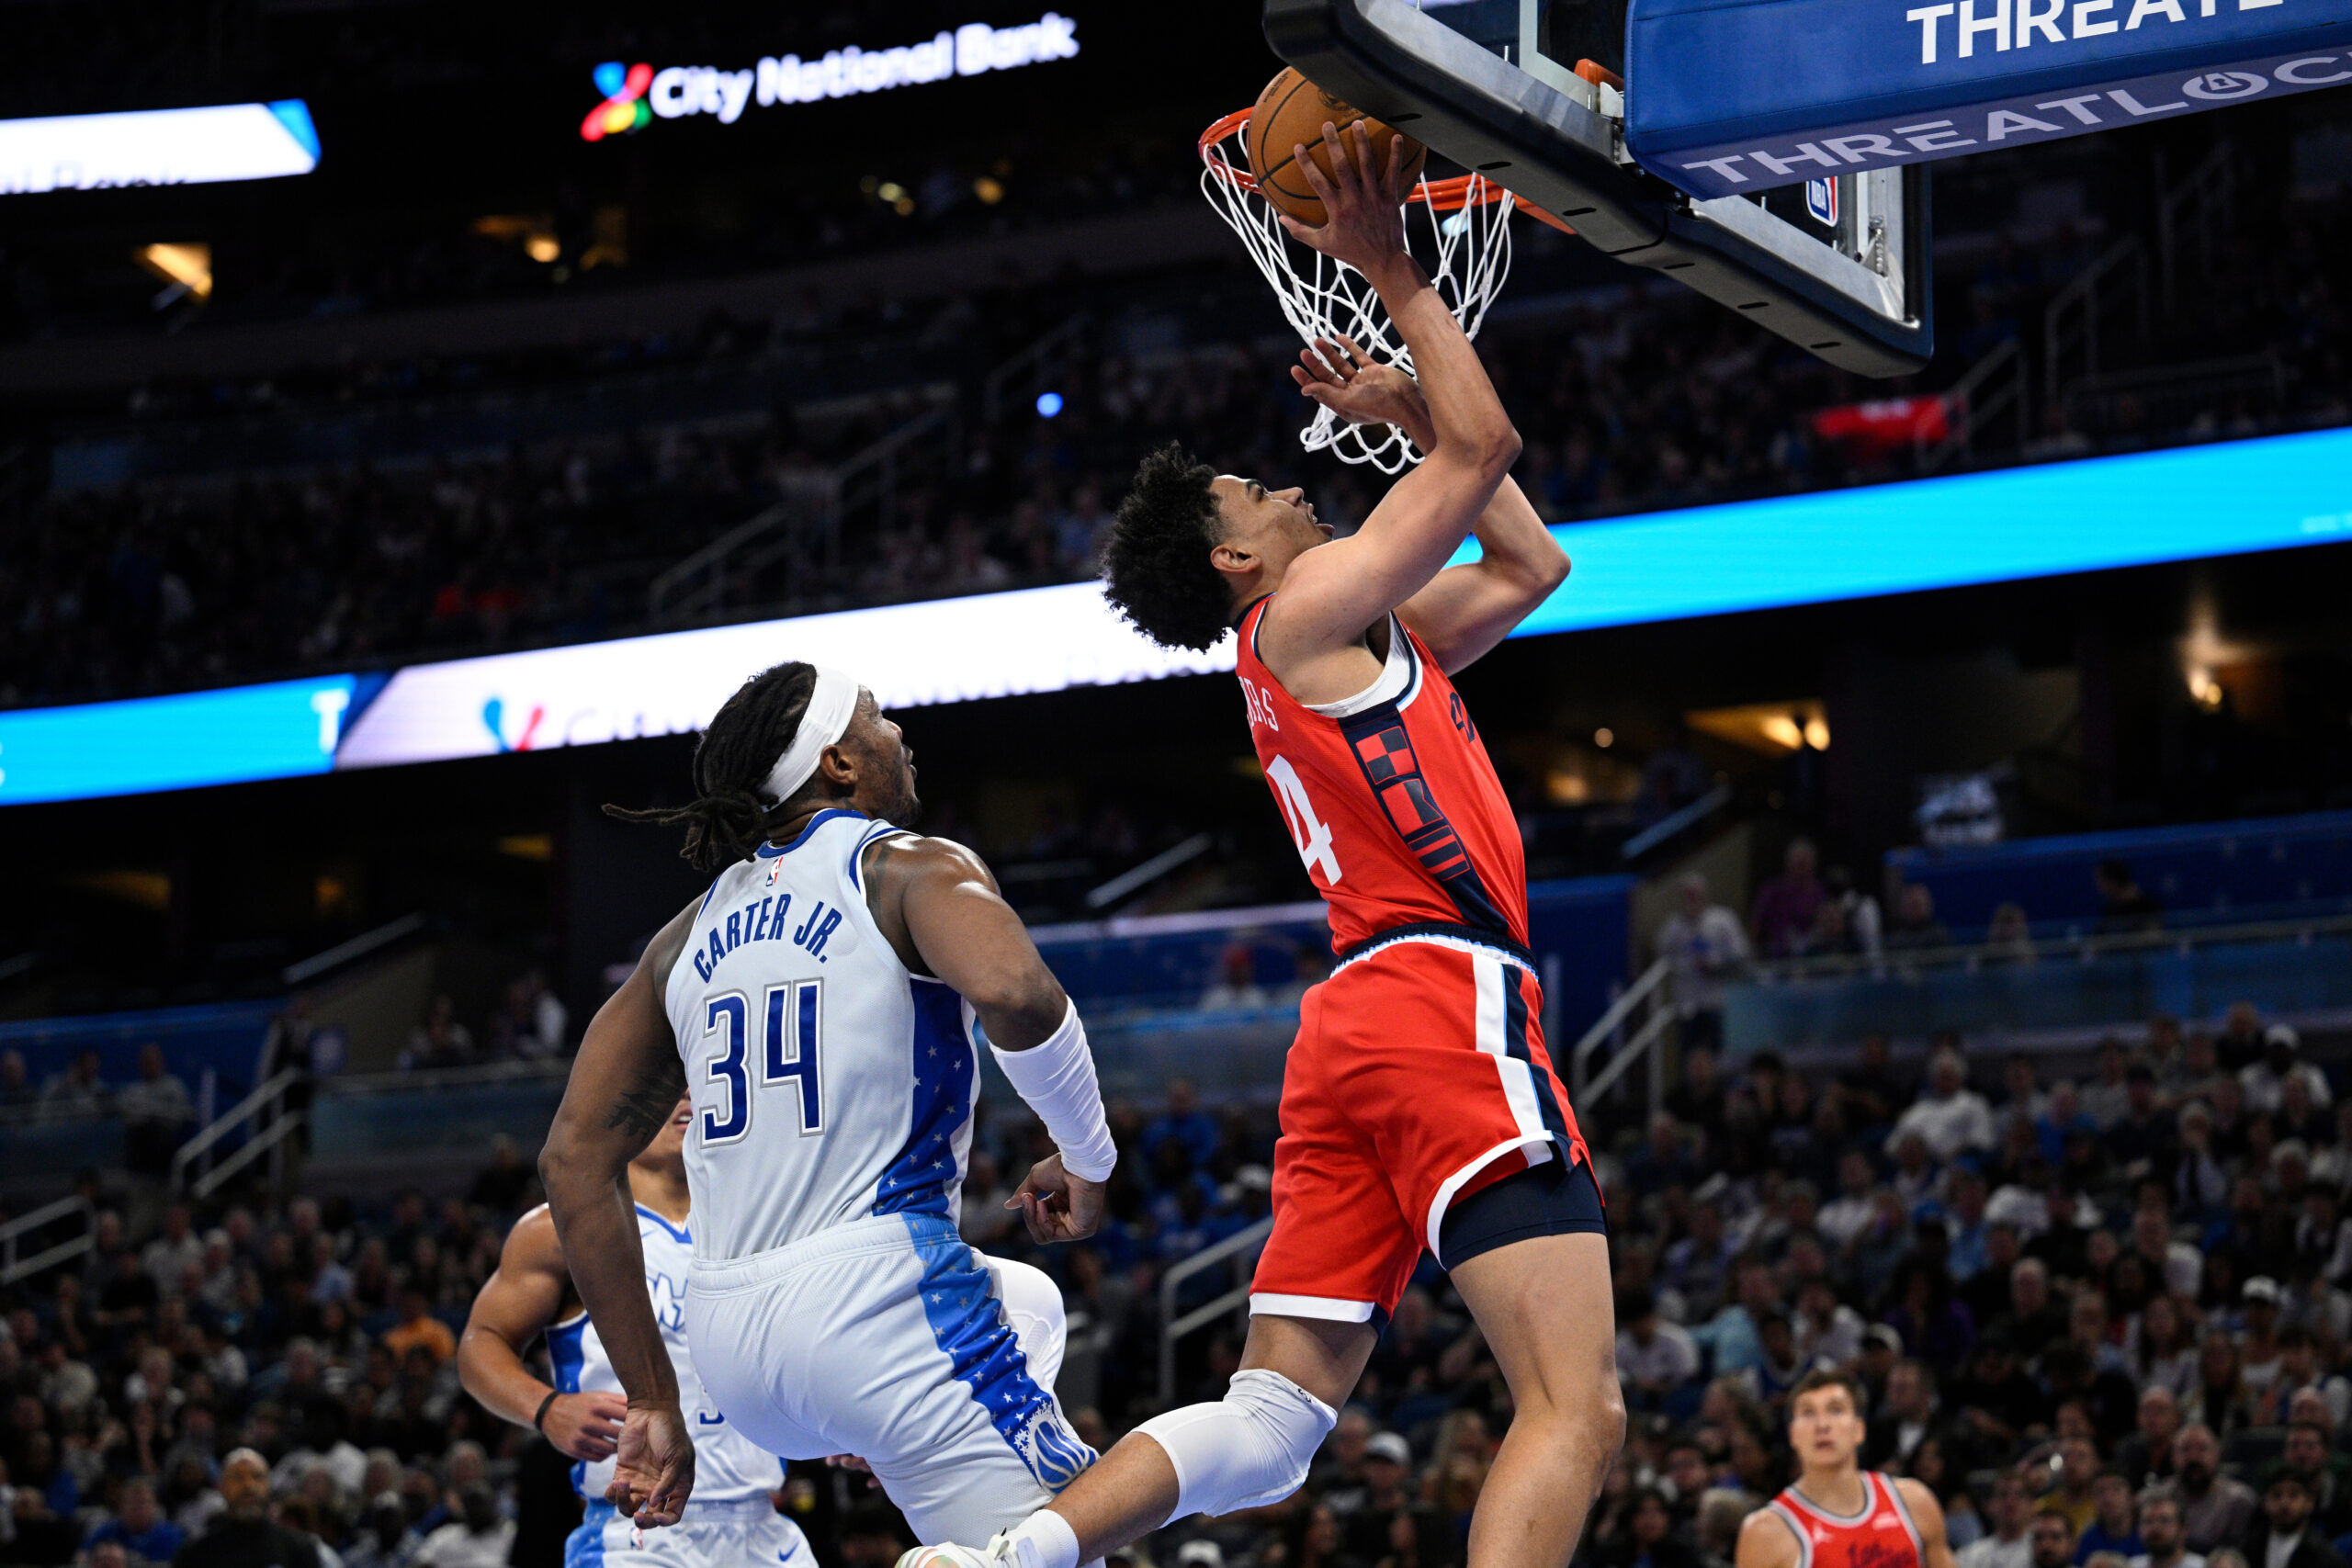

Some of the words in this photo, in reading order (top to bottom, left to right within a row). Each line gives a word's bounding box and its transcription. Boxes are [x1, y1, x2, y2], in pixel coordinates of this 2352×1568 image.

[649, 66, 755, 124] City
[756, 31, 955, 107] National
[956, 12, 1080, 77] Bank
[1681, 50, 2352, 183] THREATLOC
[693, 893, 792, 985] CARTER
[793, 900, 842, 964] JR.
[700, 976, 826, 1150] 34
